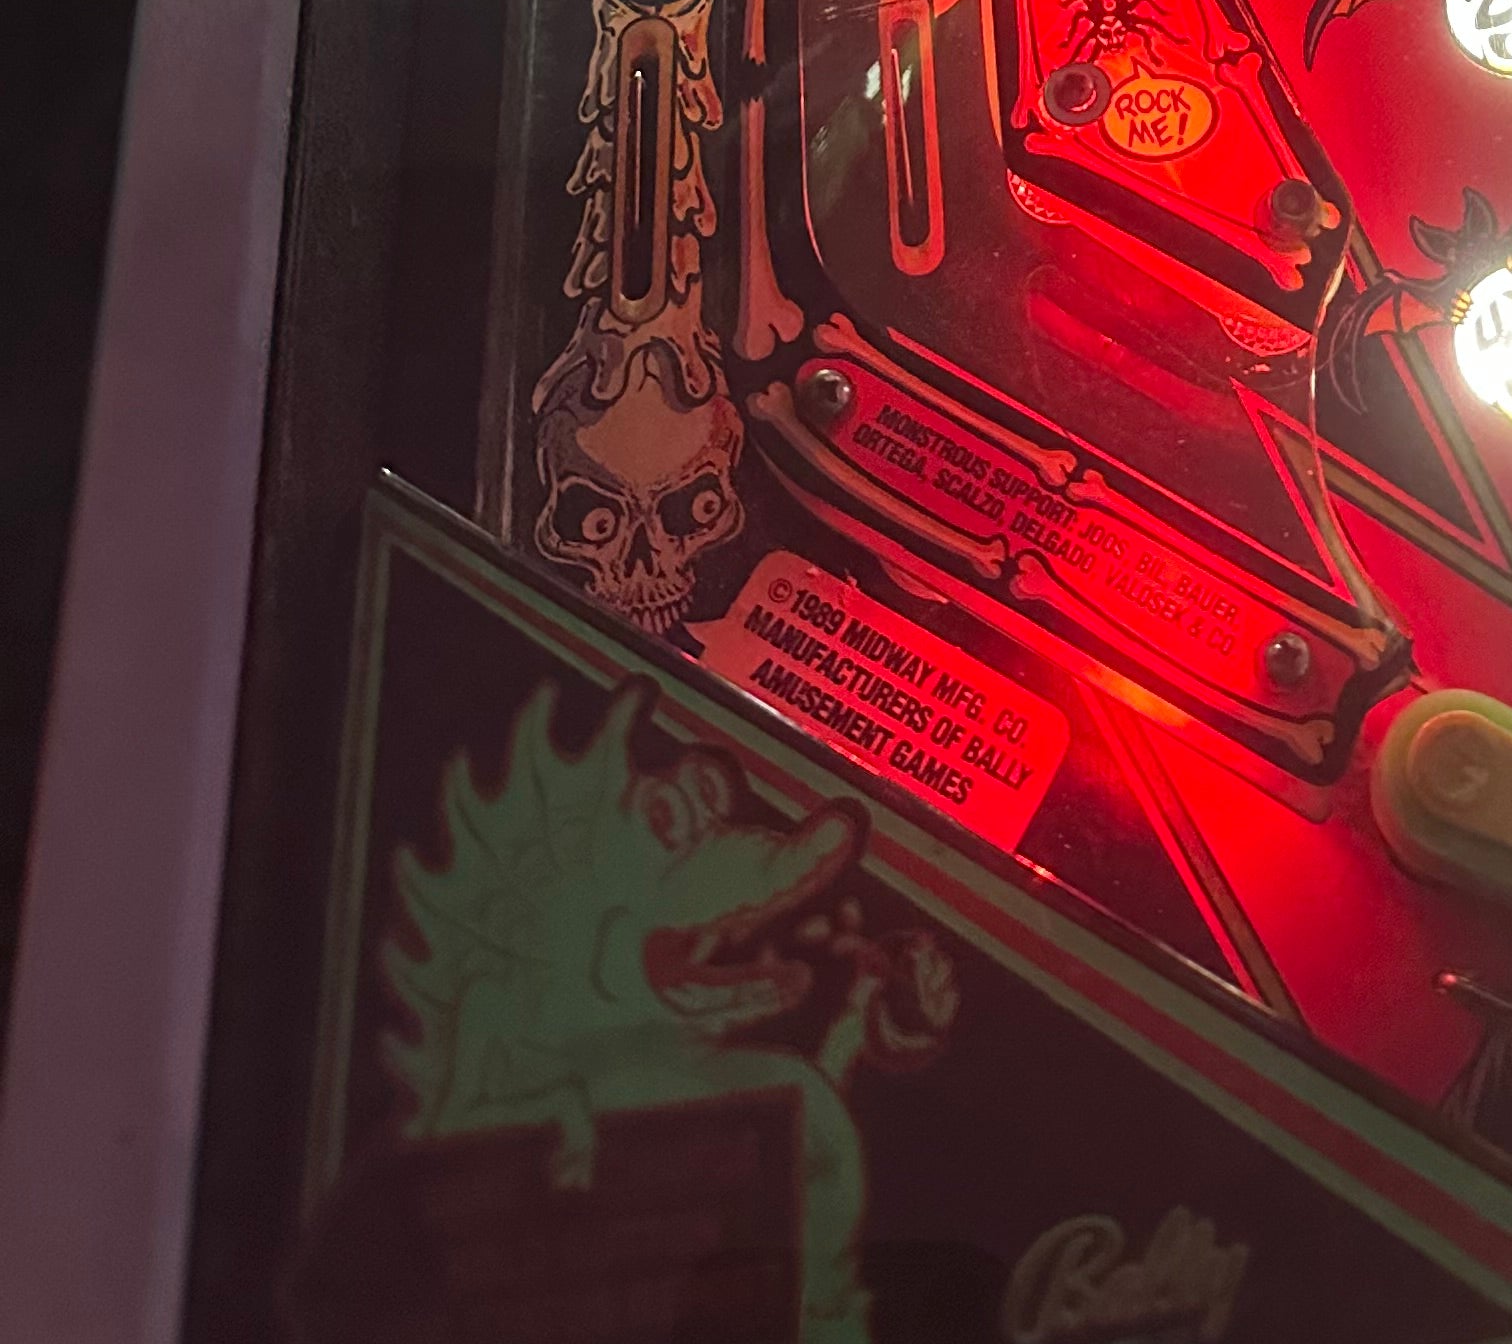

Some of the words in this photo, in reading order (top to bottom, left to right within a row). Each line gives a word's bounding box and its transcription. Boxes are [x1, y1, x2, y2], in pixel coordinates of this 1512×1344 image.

[1115, 86, 1192, 121] ROCK
[1127, 112, 1189, 149] ME!
[876, 404, 992, 481] MONSTROUS
[852, 423, 929, 482] ORTEGA,
[1187, 619, 1206, 640] &
[743, 604, 934, 735] MANUFACTURERS
[929, 714, 968, 750] OF
[960, 734, 1036, 791] BALLY
[749, 658, 895, 758] AMUSEMENT
[888, 739, 974, 806] GAMES
[840, 617, 939, 690] MIDWAY
[930, 670, 988, 726] MFG.
[992, 707, 1030, 749] CO.
